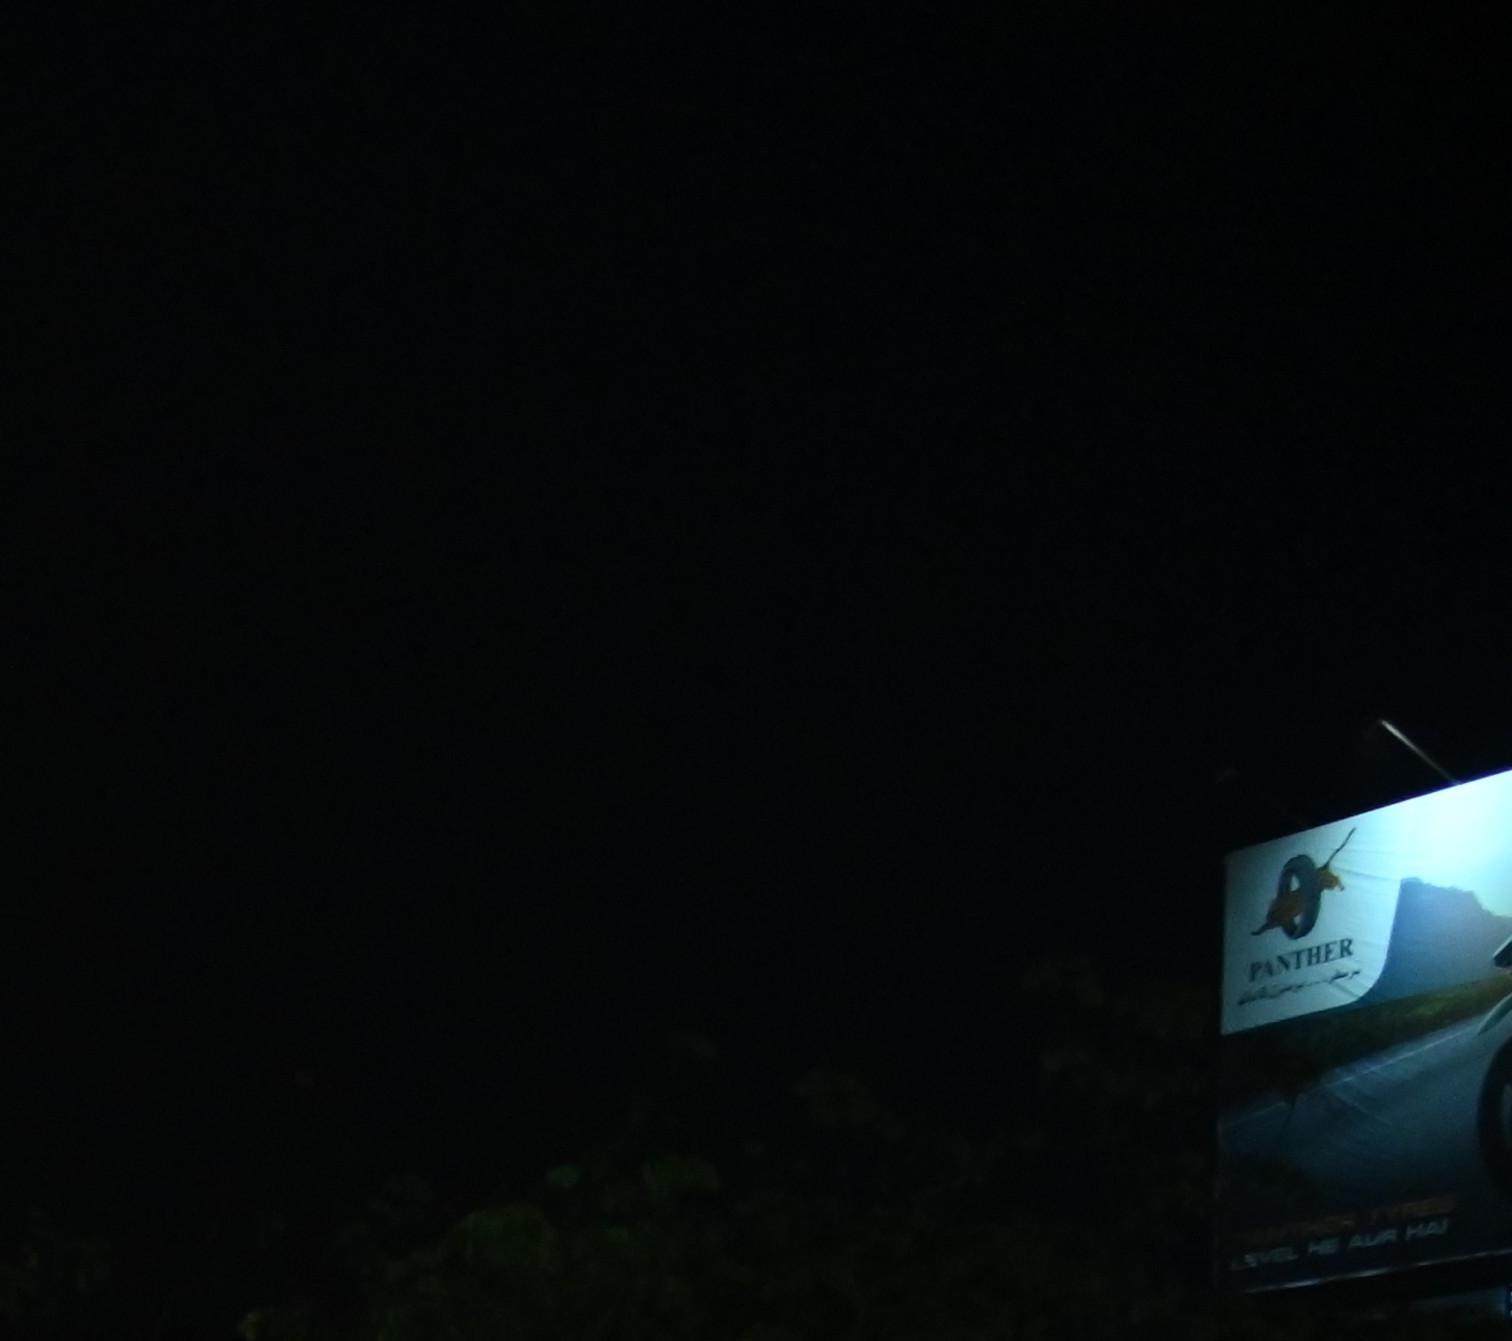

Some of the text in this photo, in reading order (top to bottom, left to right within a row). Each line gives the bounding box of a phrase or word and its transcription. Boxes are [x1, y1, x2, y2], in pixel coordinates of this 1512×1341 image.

[1249, 938, 1354, 982] PANTHER
[1346, 1228, 1398, 1249] AUR
[1405, 1218, 1449, 1240] HAI
